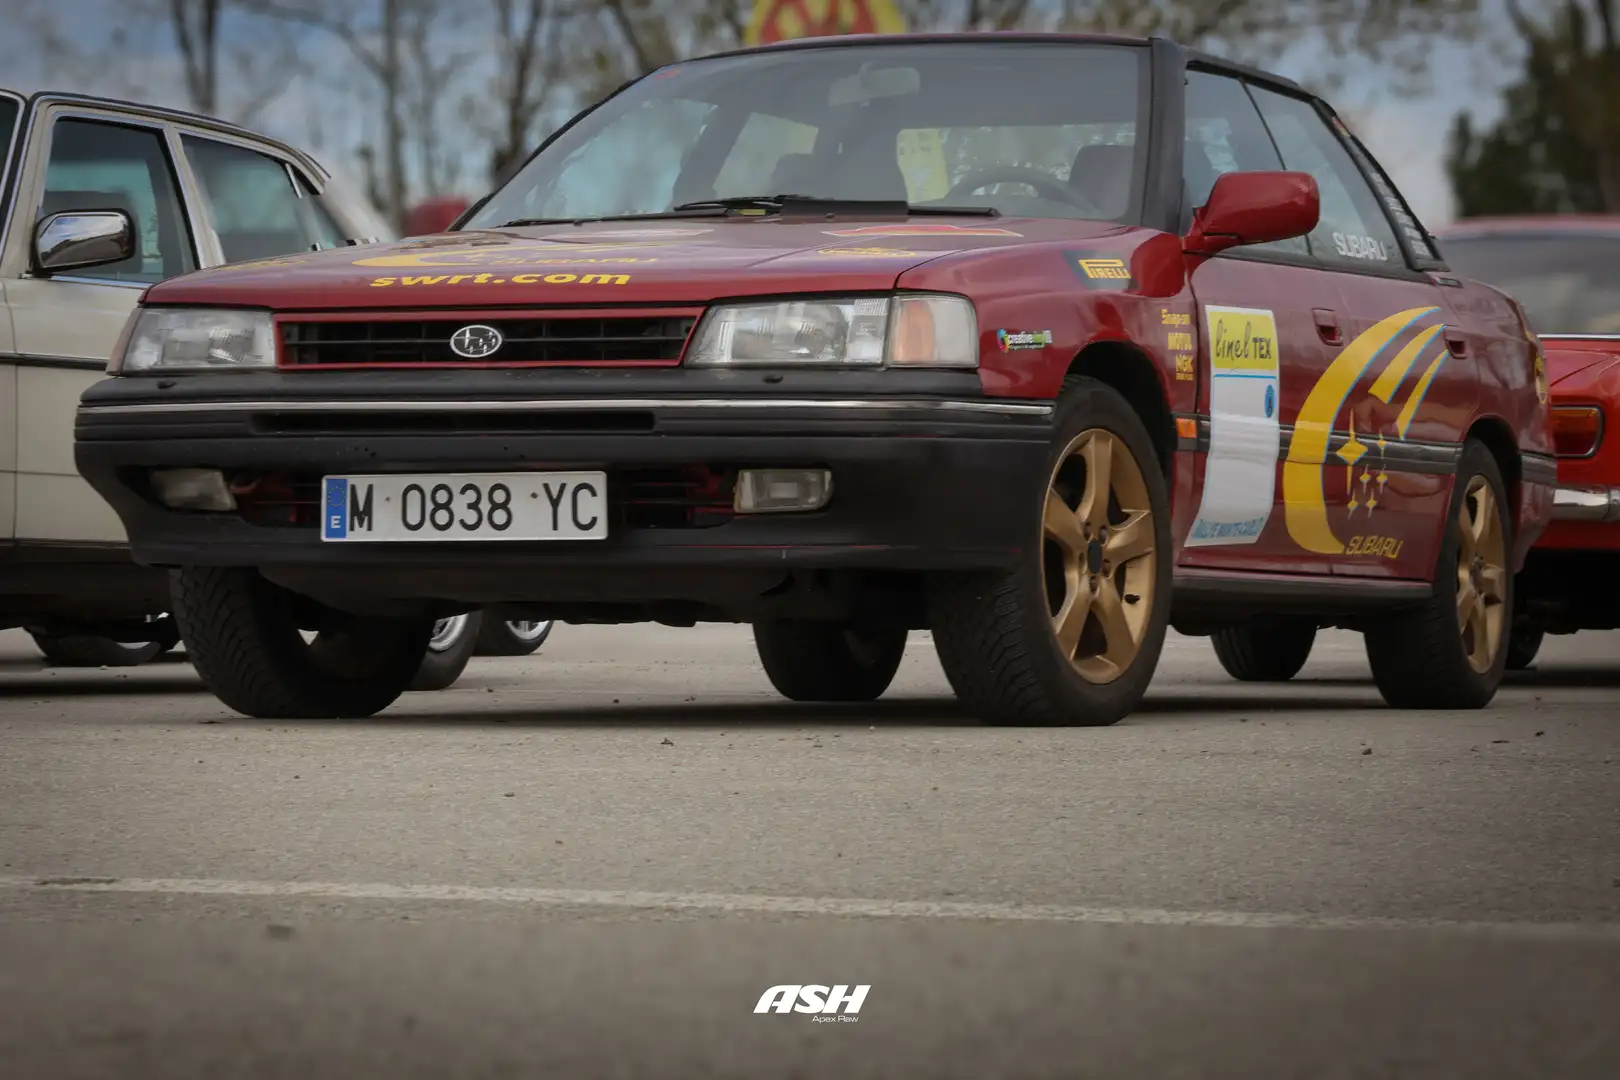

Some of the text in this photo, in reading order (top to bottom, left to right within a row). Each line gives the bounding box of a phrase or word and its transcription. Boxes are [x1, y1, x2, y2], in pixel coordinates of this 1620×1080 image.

[1332, 232, 1388, 261] SUBARU
[369, 272, 631, 287] swrt.com
[1078, 259, 1132, 279] PIRELLI
[1252, 336, 1272, 359] TEX
[349, 482, 598, 532] M 0838 YC
[330, 515, 341, 529] E
[1346, 535, 1404, 558] SUBARU
